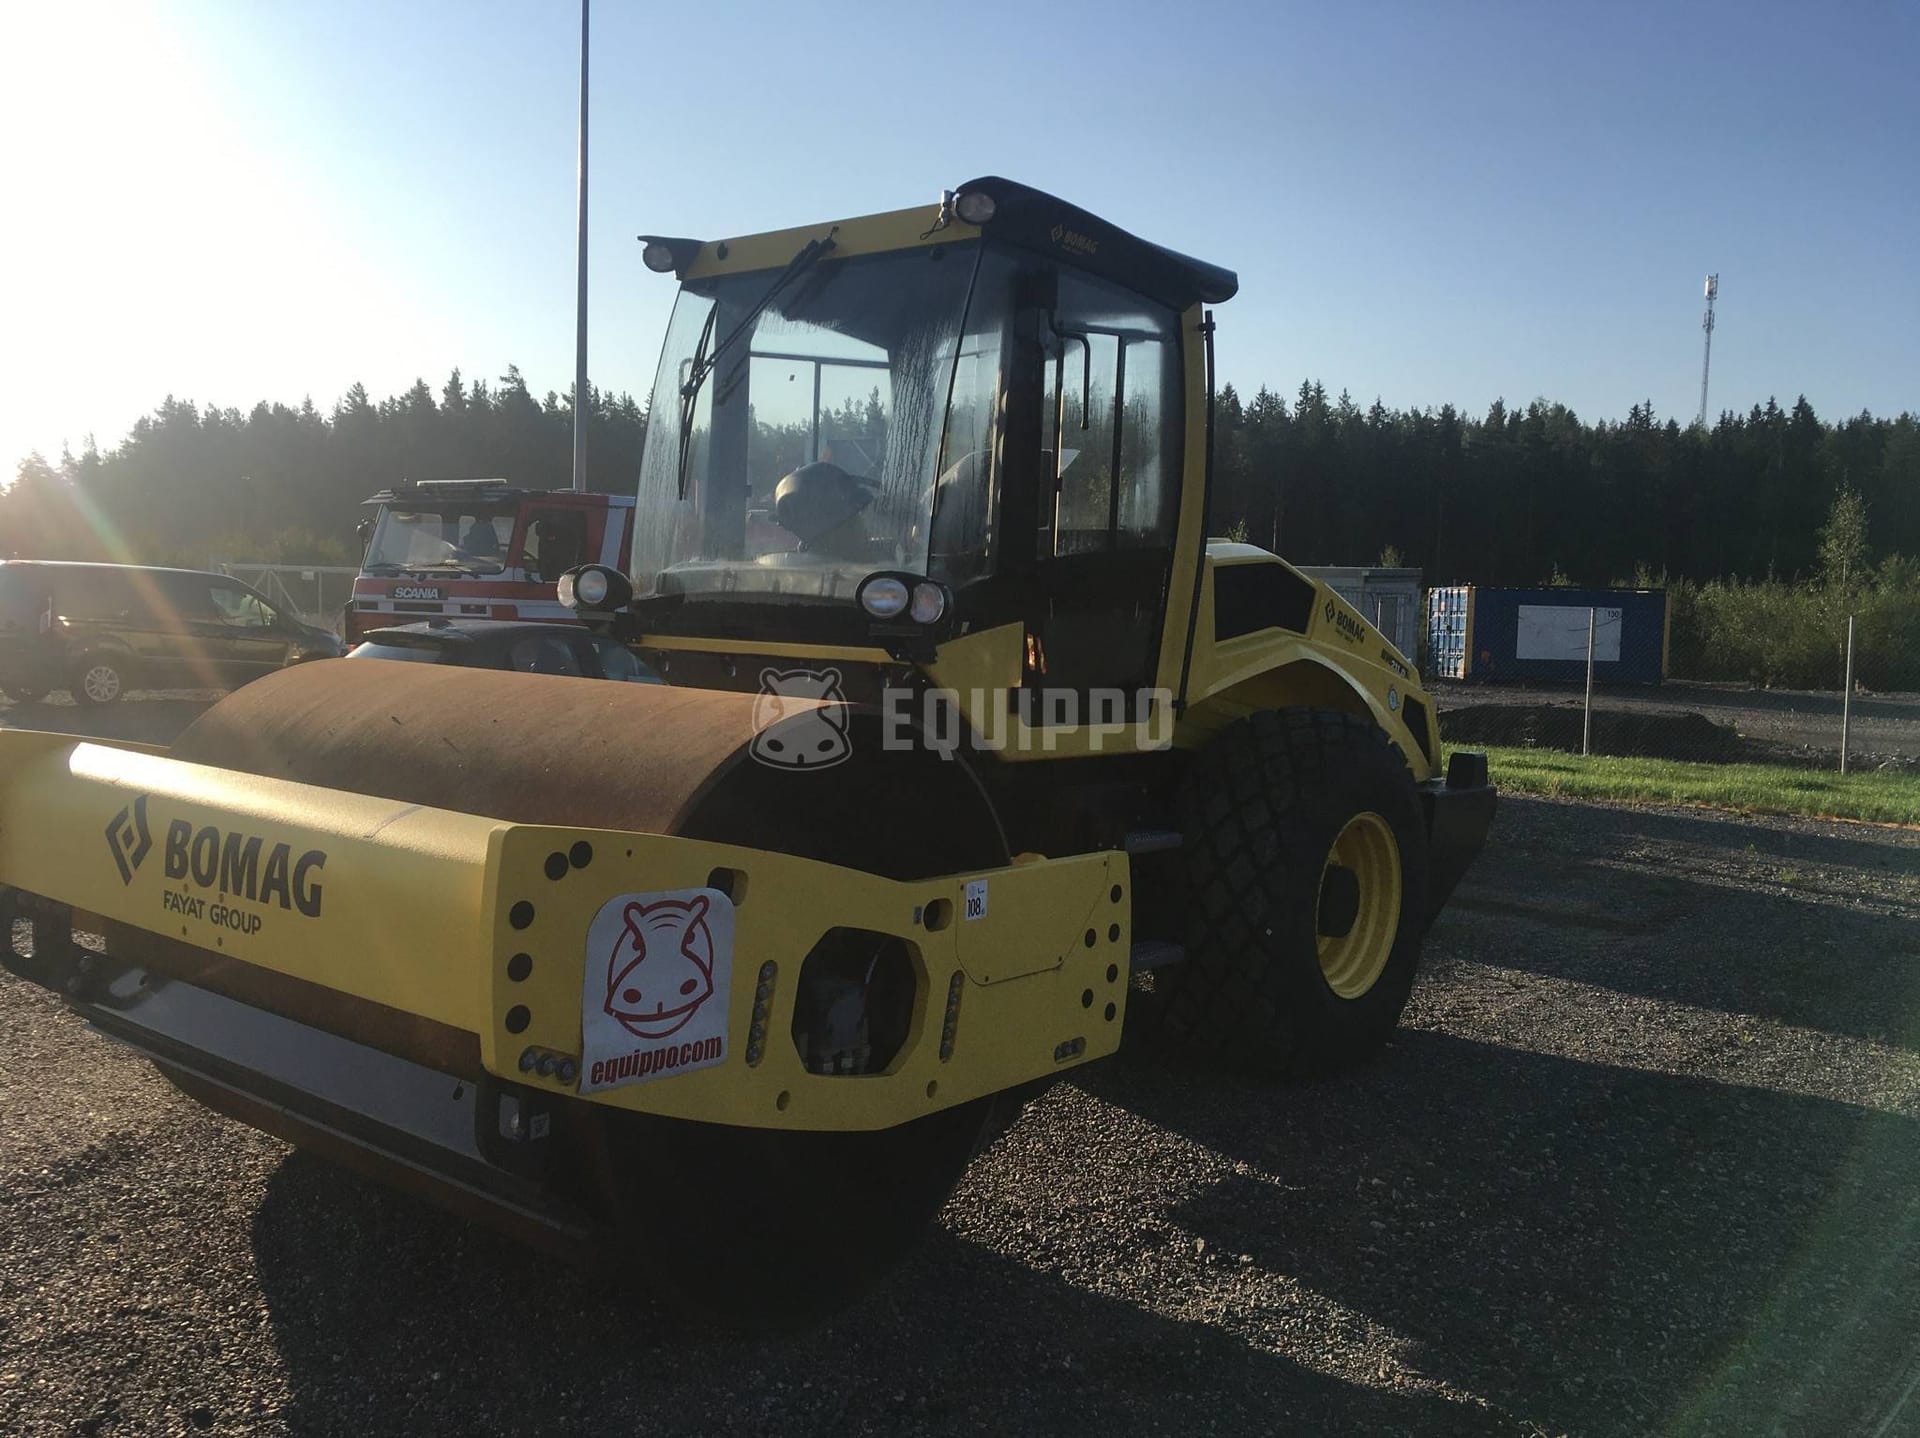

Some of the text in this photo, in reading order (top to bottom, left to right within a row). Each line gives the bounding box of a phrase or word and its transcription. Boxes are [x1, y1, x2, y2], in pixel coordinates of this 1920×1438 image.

[394, 587, 439, 599] SCANIA
[1336, 610, 1365, 643] BOMAG
[165, 819, 327, 917] BOMAG
[163, 890, 262, 935] FAYAT GROUP
[967, 898, 981, 917] 108
[592, 1036, 722, 1085] equippo.com
